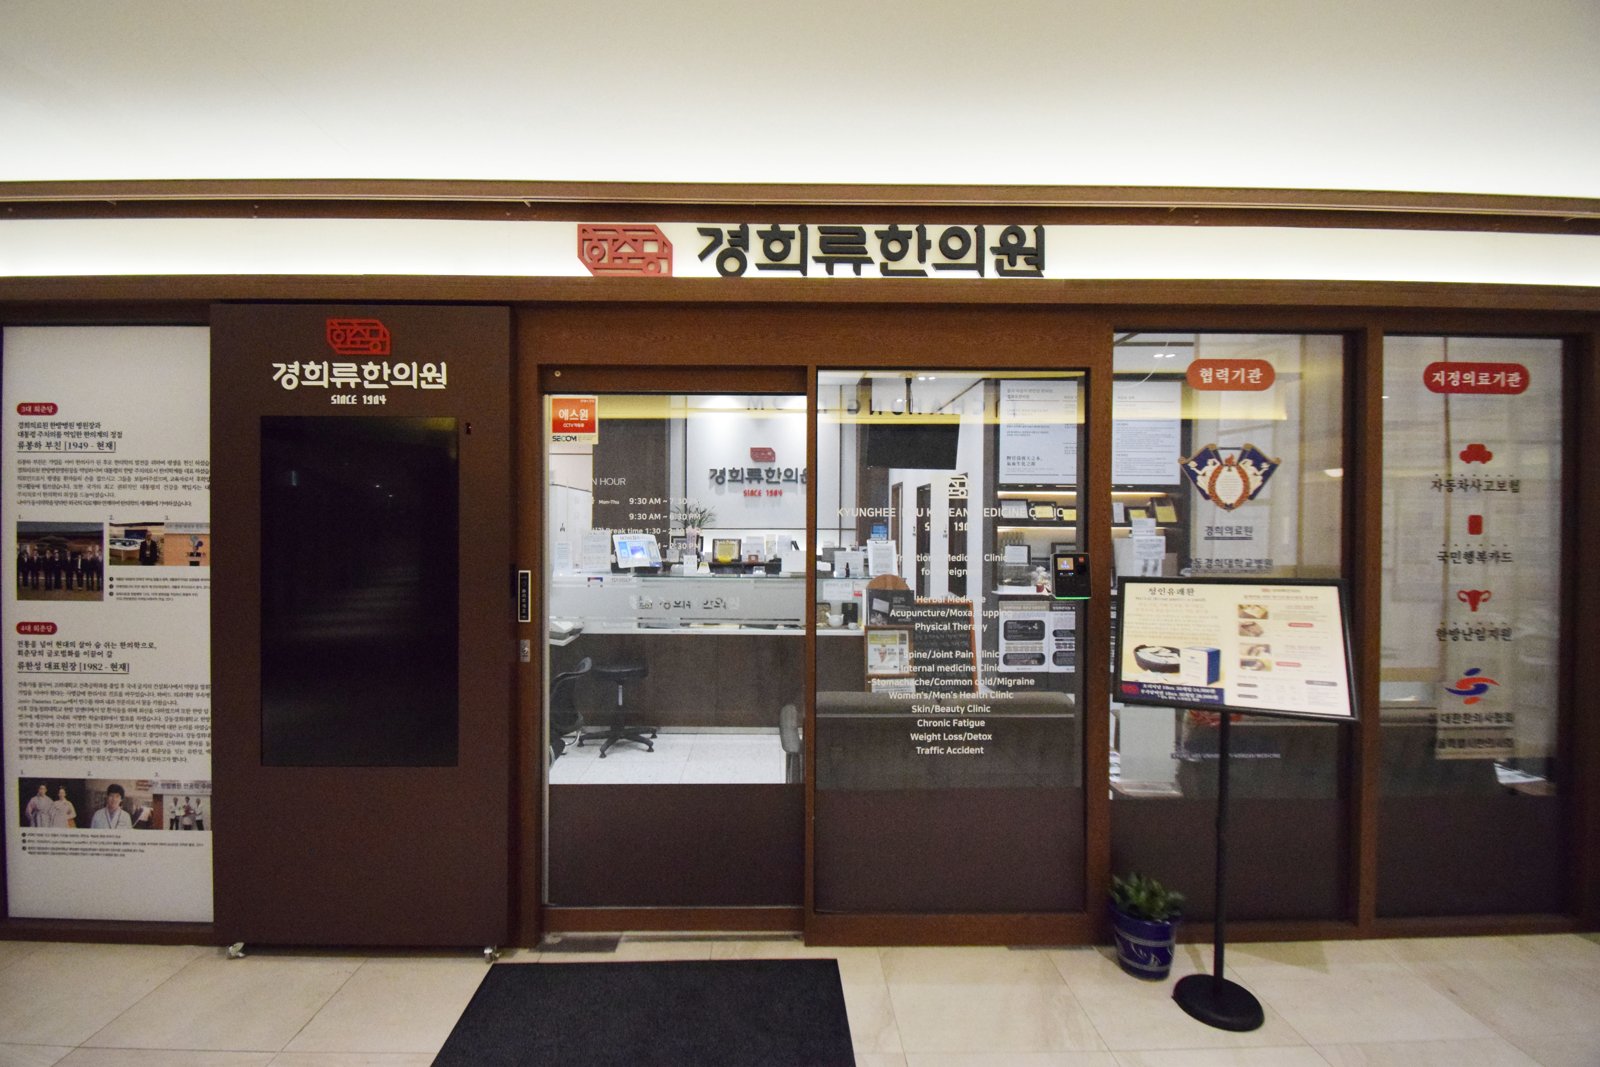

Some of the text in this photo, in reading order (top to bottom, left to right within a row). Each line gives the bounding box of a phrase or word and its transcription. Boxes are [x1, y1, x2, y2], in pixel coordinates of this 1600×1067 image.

[697, 222, 1045, 277] 경희류한의원
[272, 360, 447, 390] 경희류한의원
[1199, 367, 1264, 384] 협력기관
[1431, 370, 1522, 388] 지정의료기관
[331, 394, 387, 405] SINCE 1904
[558, 408, 588, 421] 에스원
[600, 477, 626, 486] HOUR
[1431, 479, 1521, 493] 자동차사고보험
[629, 497, 647, 505] 9:30
[648, 497, 661, 505] AM
[837, 507, 896, 518] KYUNGHEE
[926, 507, 969, 518] KEAN
[983, 507, 1026, 518] EDICINE
[1028, 507, 1065, 518] CIC
[1205, 526, 1253, 536] 경희의료원
[984, 553, 1007, 562] Clinic
[1437, 551, 1513, 564] 국민행복카드
[948, 595, 987, 604] Medice
[915, 622, 988, 634] Physical Theray
[1435, 627, 1512, 642] 한방난임지원
[955, 651, 974, 660] Pain
[44, 662, 77, 671] 대표원장
[901, 664, 935, 673] Internal
[937, 664, 976, 673] medicine
[889, 691, 1014, 700] Women's/Men's Health Clinic
[911, 705, 991, 715] Skin/Beauty Clinic
[917, 719, 986, 730] Chronic Fatigue
[910, 733, 993, 743] Weight Loss/Detox
[916, 746, 984, 755] Traffic Accident
